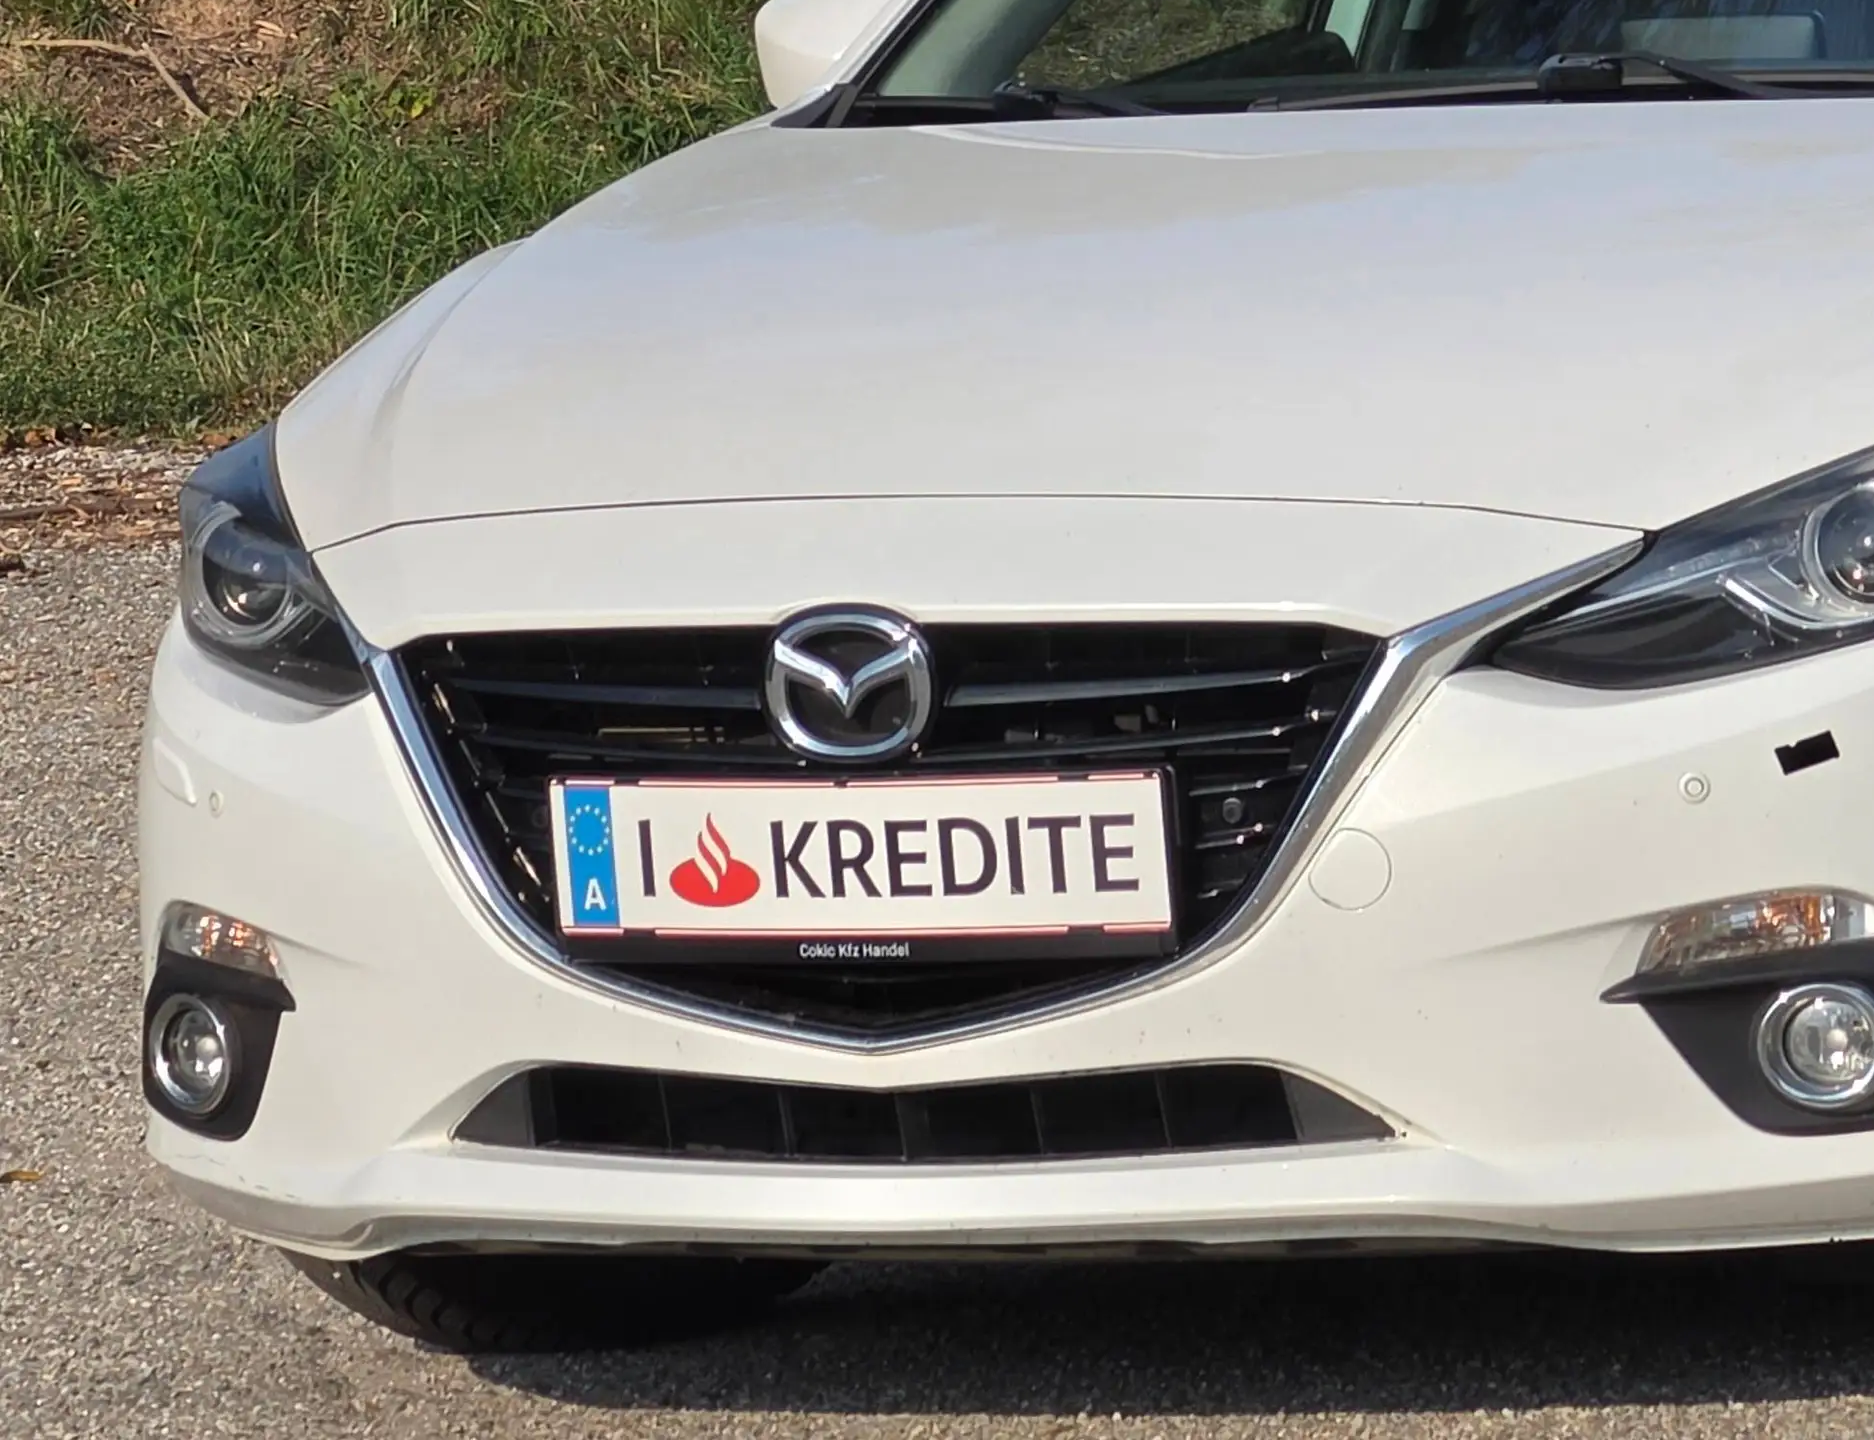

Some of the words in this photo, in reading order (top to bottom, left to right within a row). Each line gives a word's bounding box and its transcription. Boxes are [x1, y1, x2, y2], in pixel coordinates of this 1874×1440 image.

[637, 819, 656, 897] I
[769, 814, 1139, 898] KREDITE
[584, 878, 607, 910] A
[838, 943, 860, 958] Kfz
[862, 942, 910, 958] Handel
